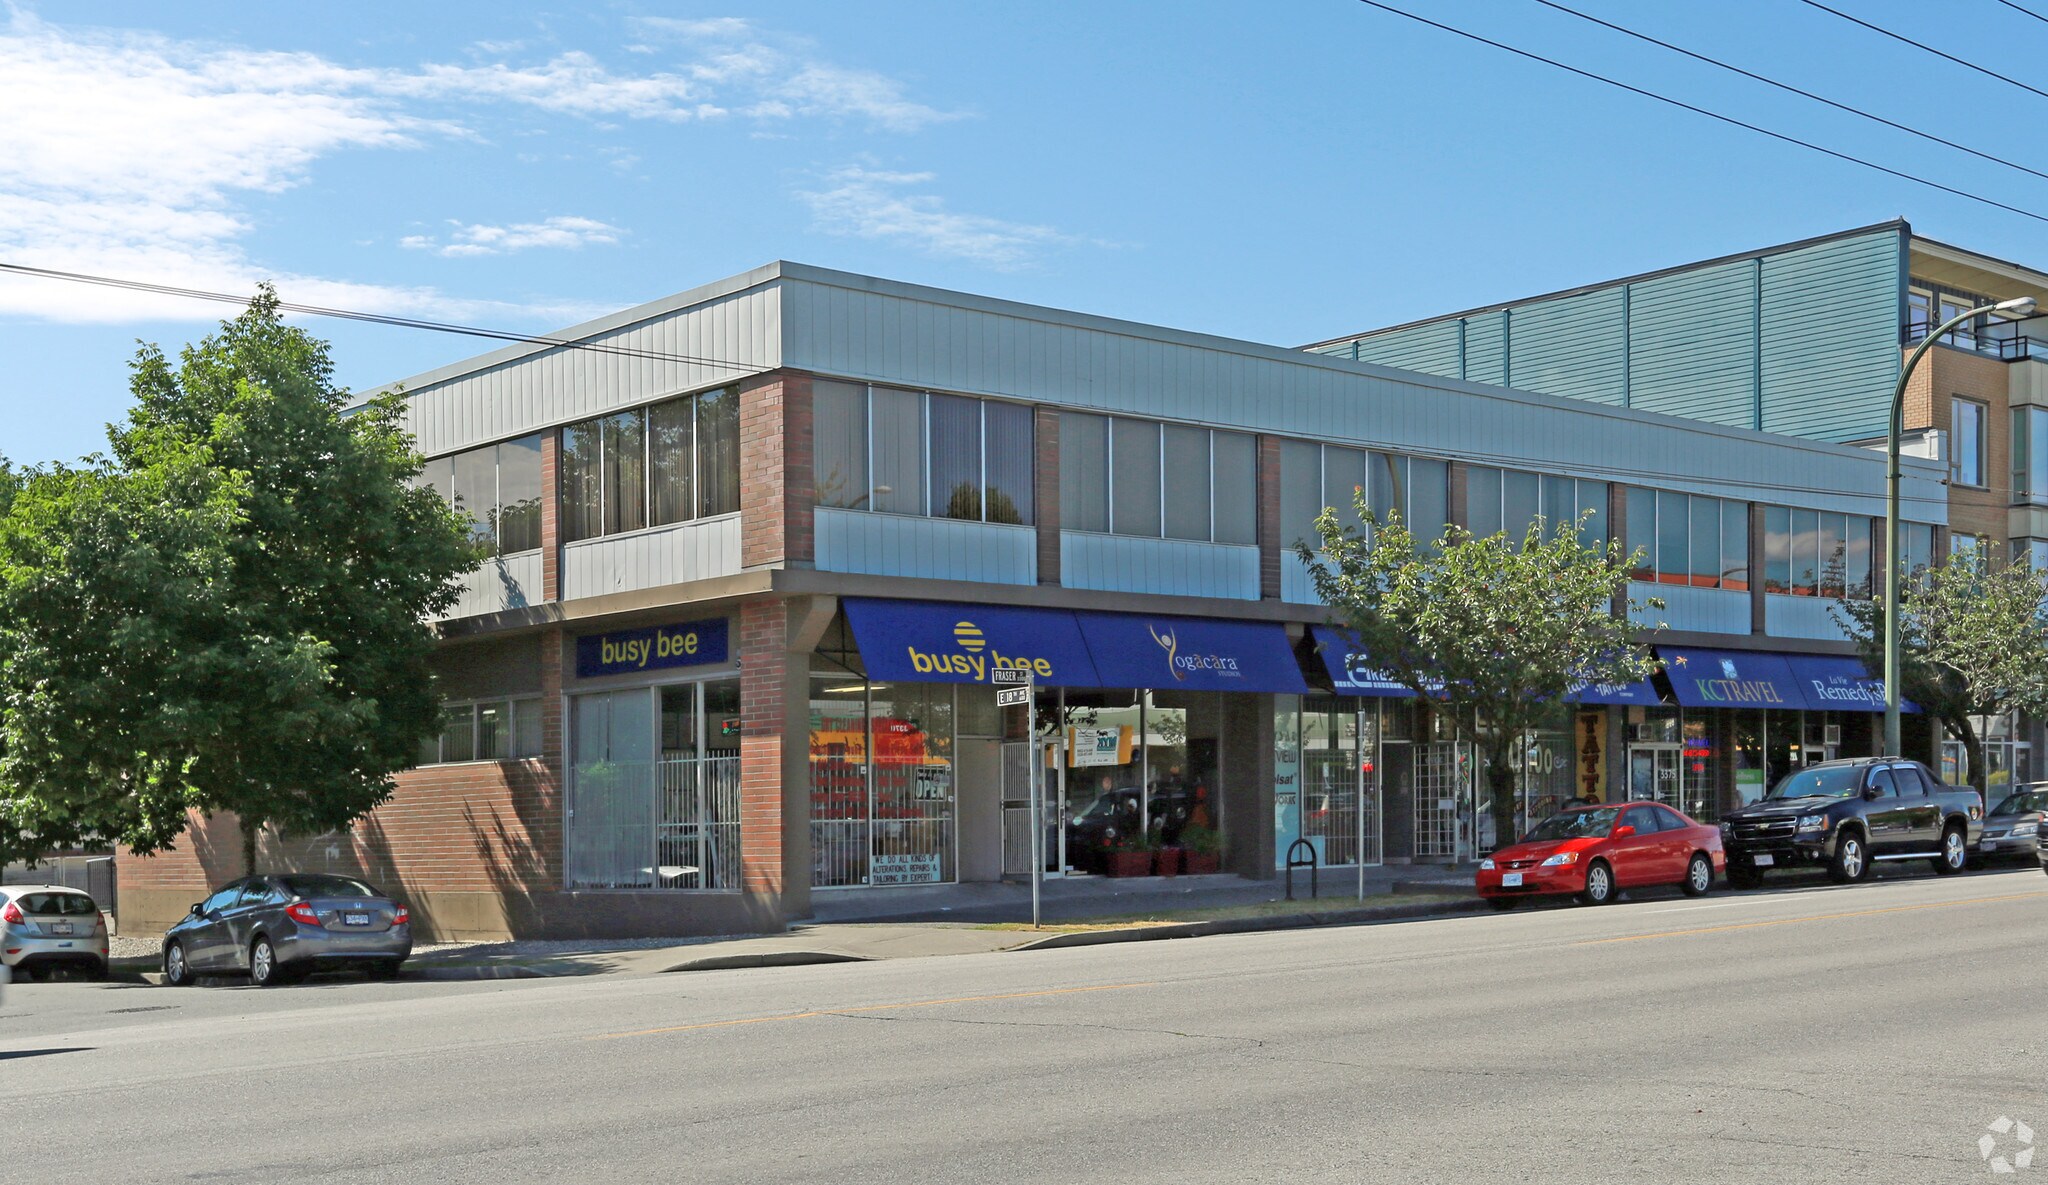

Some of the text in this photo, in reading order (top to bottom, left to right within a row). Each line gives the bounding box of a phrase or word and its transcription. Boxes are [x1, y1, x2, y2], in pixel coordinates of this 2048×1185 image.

[602, 629, 698, 667] busy bee
[908, 646, 1052, 681] busy bee
[995, 671, 1017, 681] FRASER
[1000, 693, 1005, 704] E
[1660, 768, 1677, 780] 3375
[915, 780, 945, 798] OPEN
[875, 854, 935, 864] WE DO ALL KINDS OF
[872, 864, 907, 873] ALTERATIONS
[910, 864, 930, 872] REPAIRS
[873, 874, 899, 882] TAILORING
